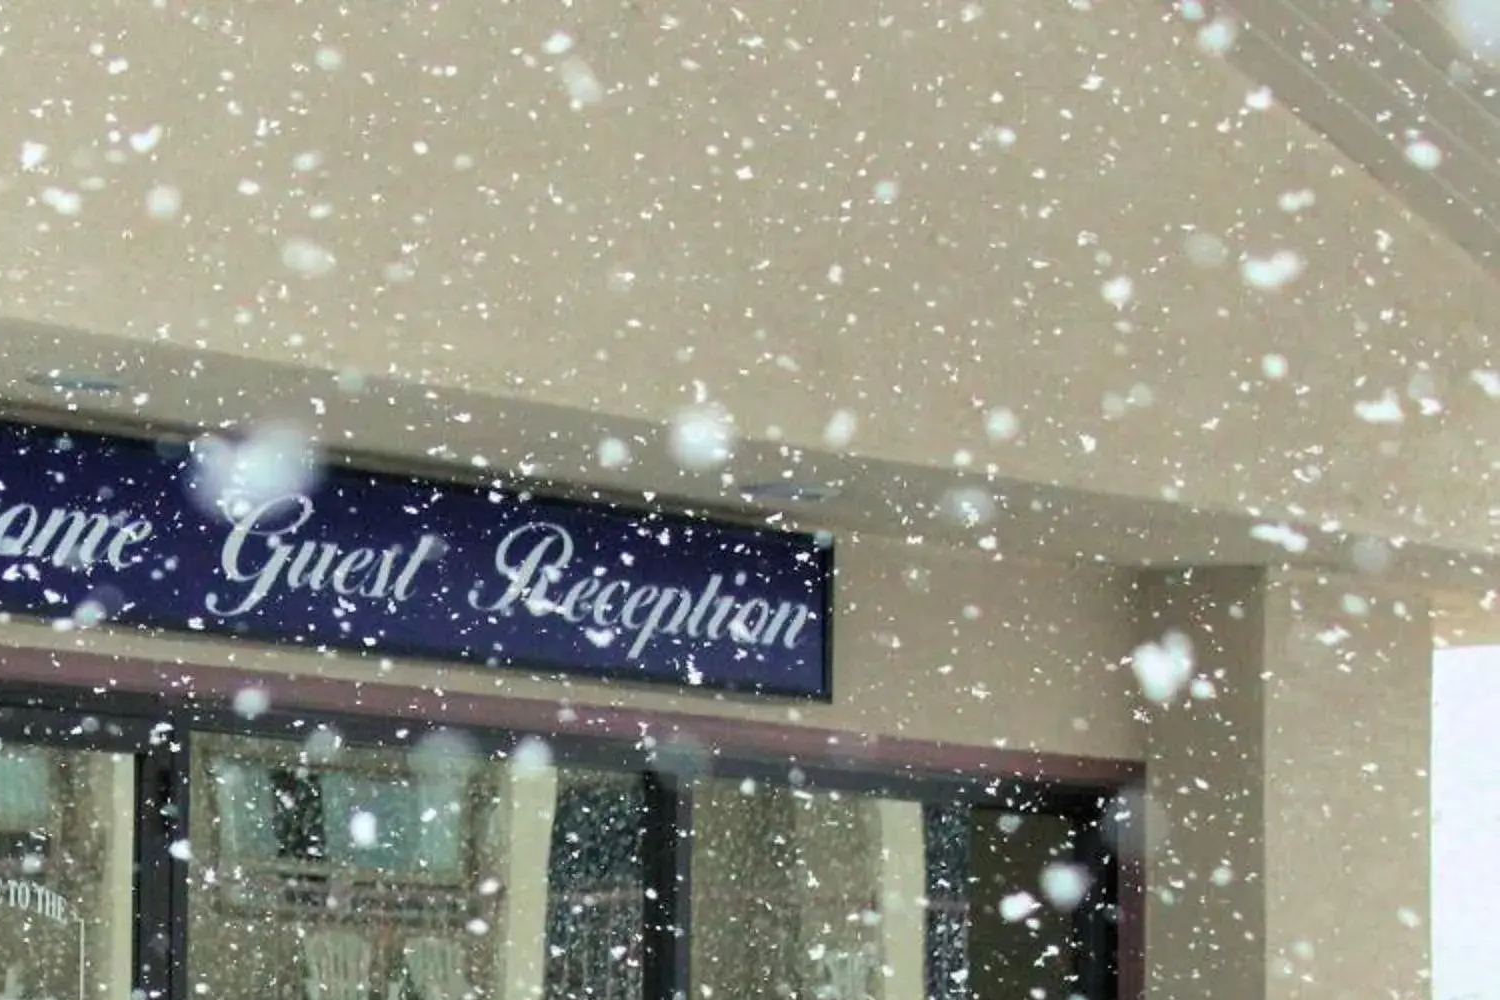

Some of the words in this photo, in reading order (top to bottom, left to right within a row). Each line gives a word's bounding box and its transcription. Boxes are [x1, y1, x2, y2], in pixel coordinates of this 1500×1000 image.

[205, 493, 442, 616] Guest
[467, 521, 807, 659] Reception
[8, 879, 31, 909] TO
[33, 883, 68, 925] THE
